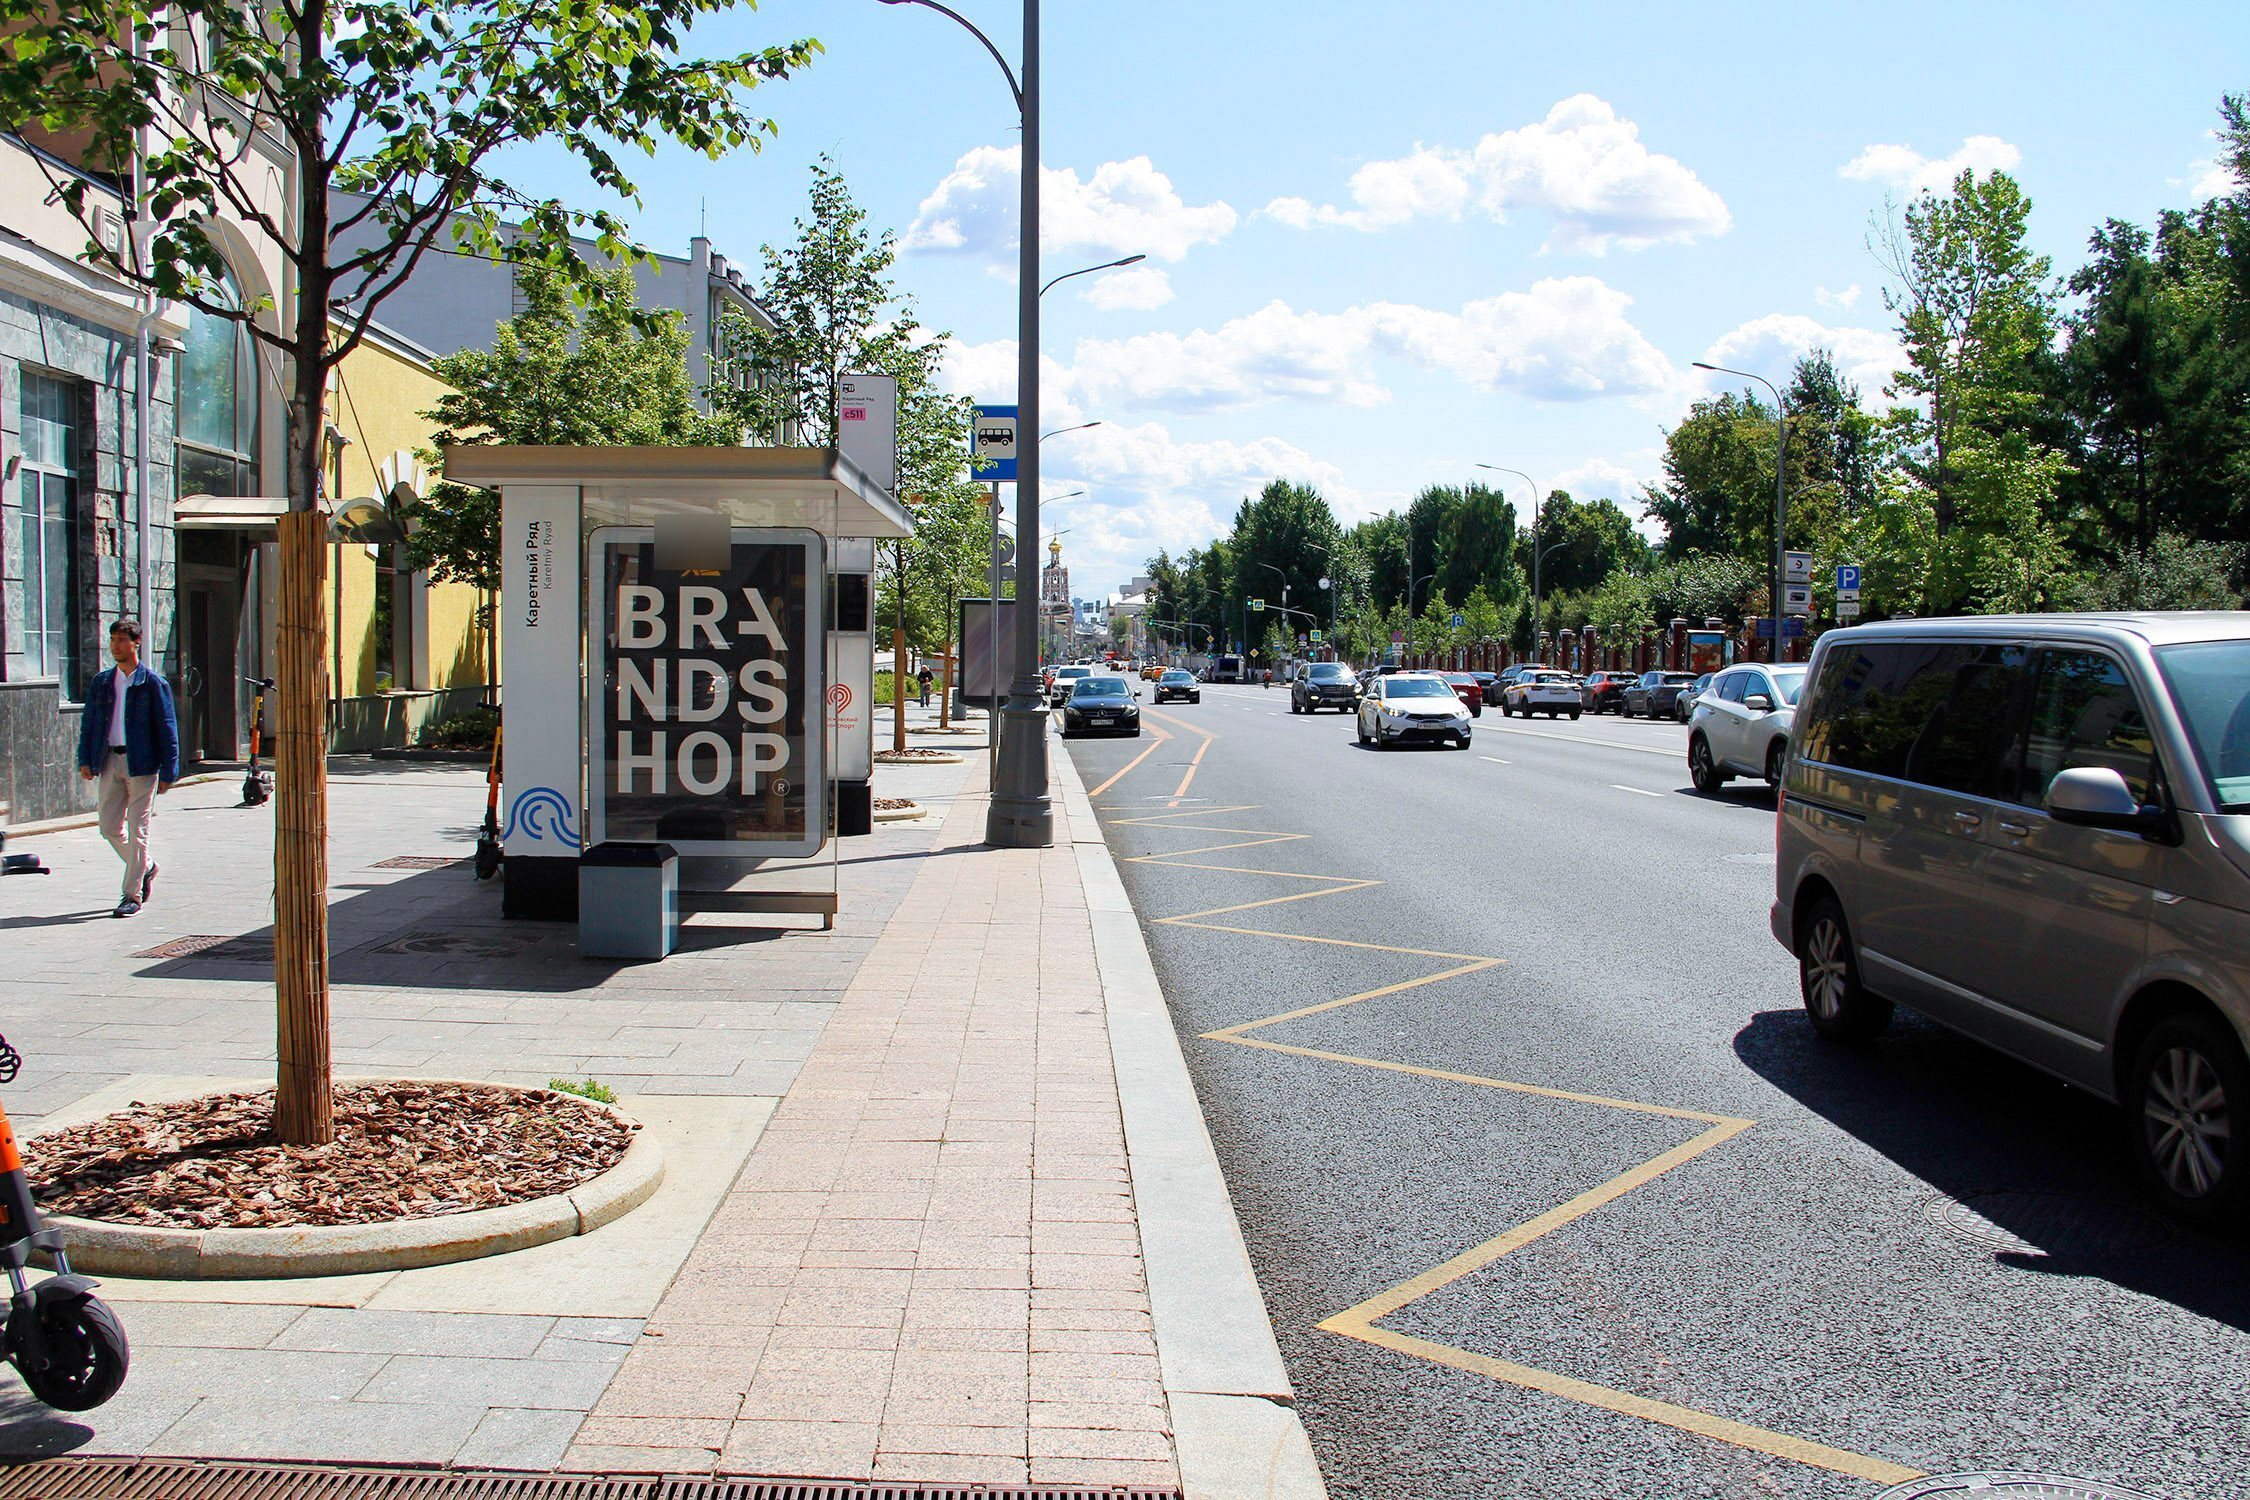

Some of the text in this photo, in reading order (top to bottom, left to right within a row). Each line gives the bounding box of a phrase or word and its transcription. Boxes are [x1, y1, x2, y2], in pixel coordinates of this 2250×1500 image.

[526, 521, 540, 627] Каретный Ряд
[543, 521, 554, 590] Karetniy Ryad
[1843, 568, 1856, 588] P
[619, 586, 789, 651] BRA
[617, 657, 788, 725] NDS
